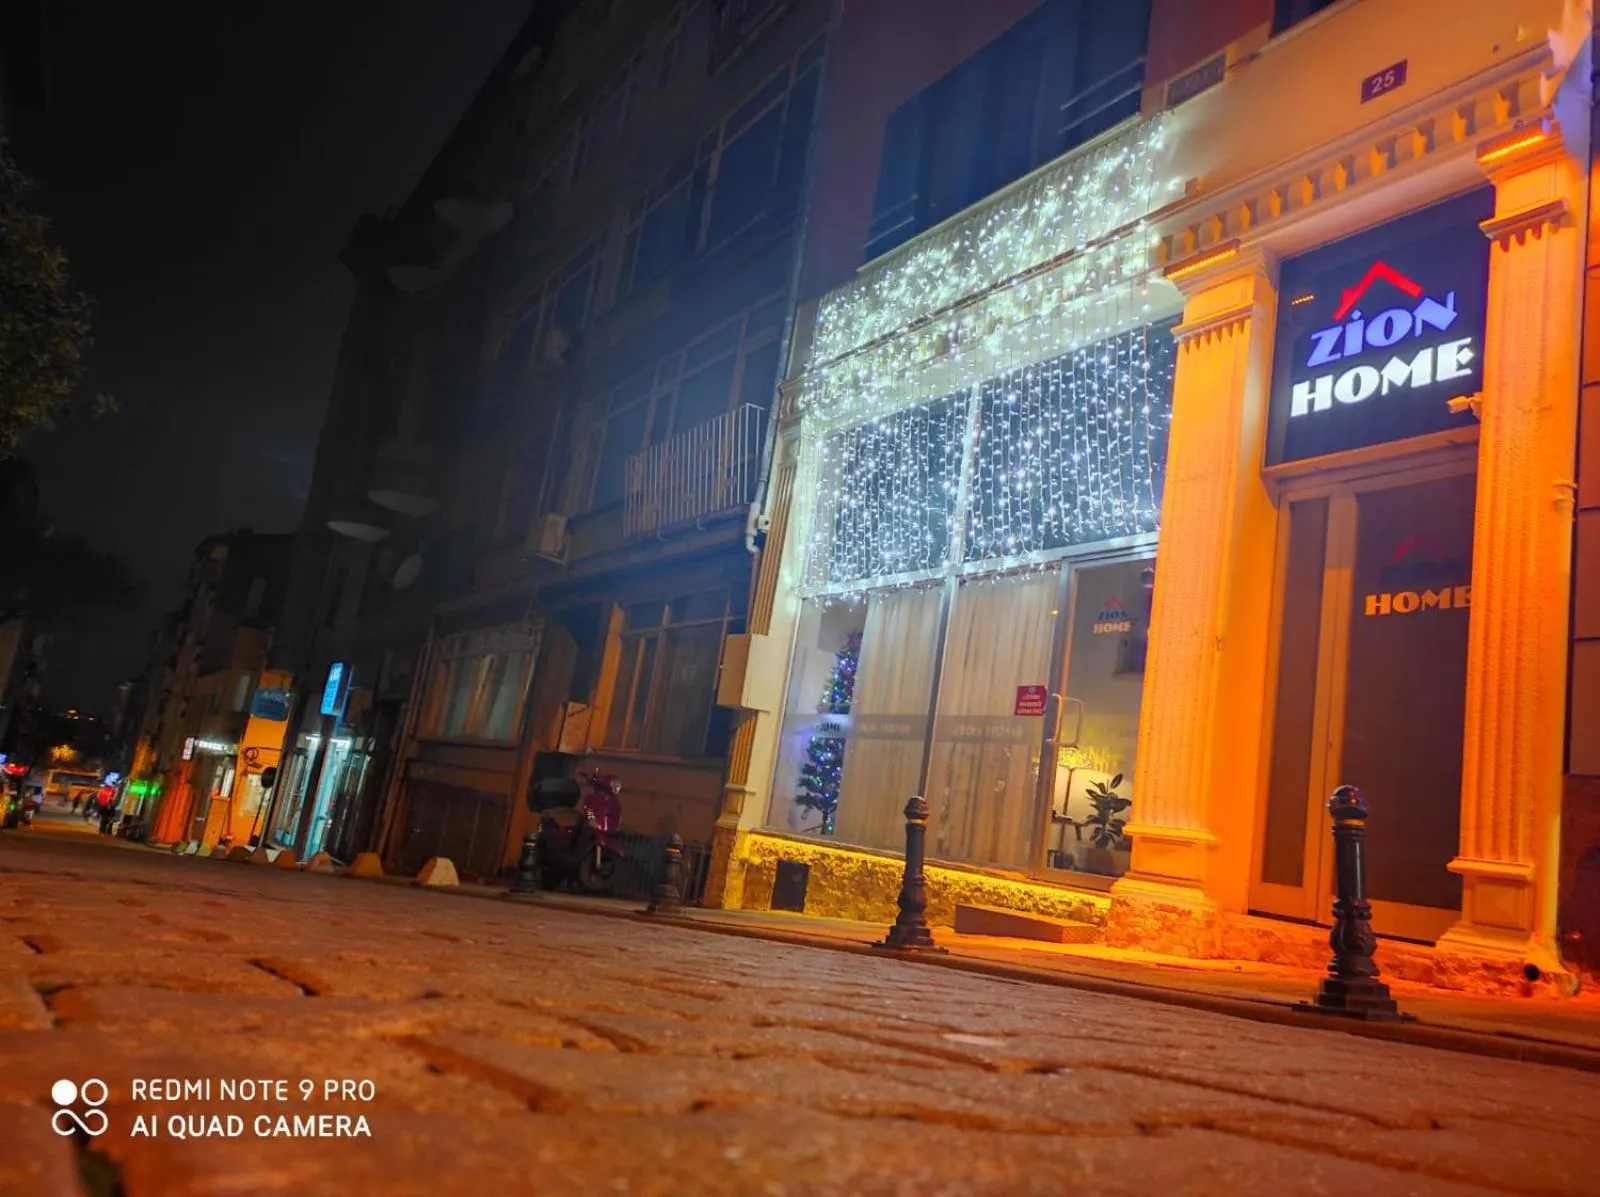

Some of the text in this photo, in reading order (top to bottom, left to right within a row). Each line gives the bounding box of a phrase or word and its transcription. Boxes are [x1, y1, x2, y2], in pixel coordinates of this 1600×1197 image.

[1371, 69, 1397, 95] 25
[1290, 337, 1475, 417] HOME
[1364, 584, 1473, 616] HOME
[1093, 621, 1133, 635] HOME
